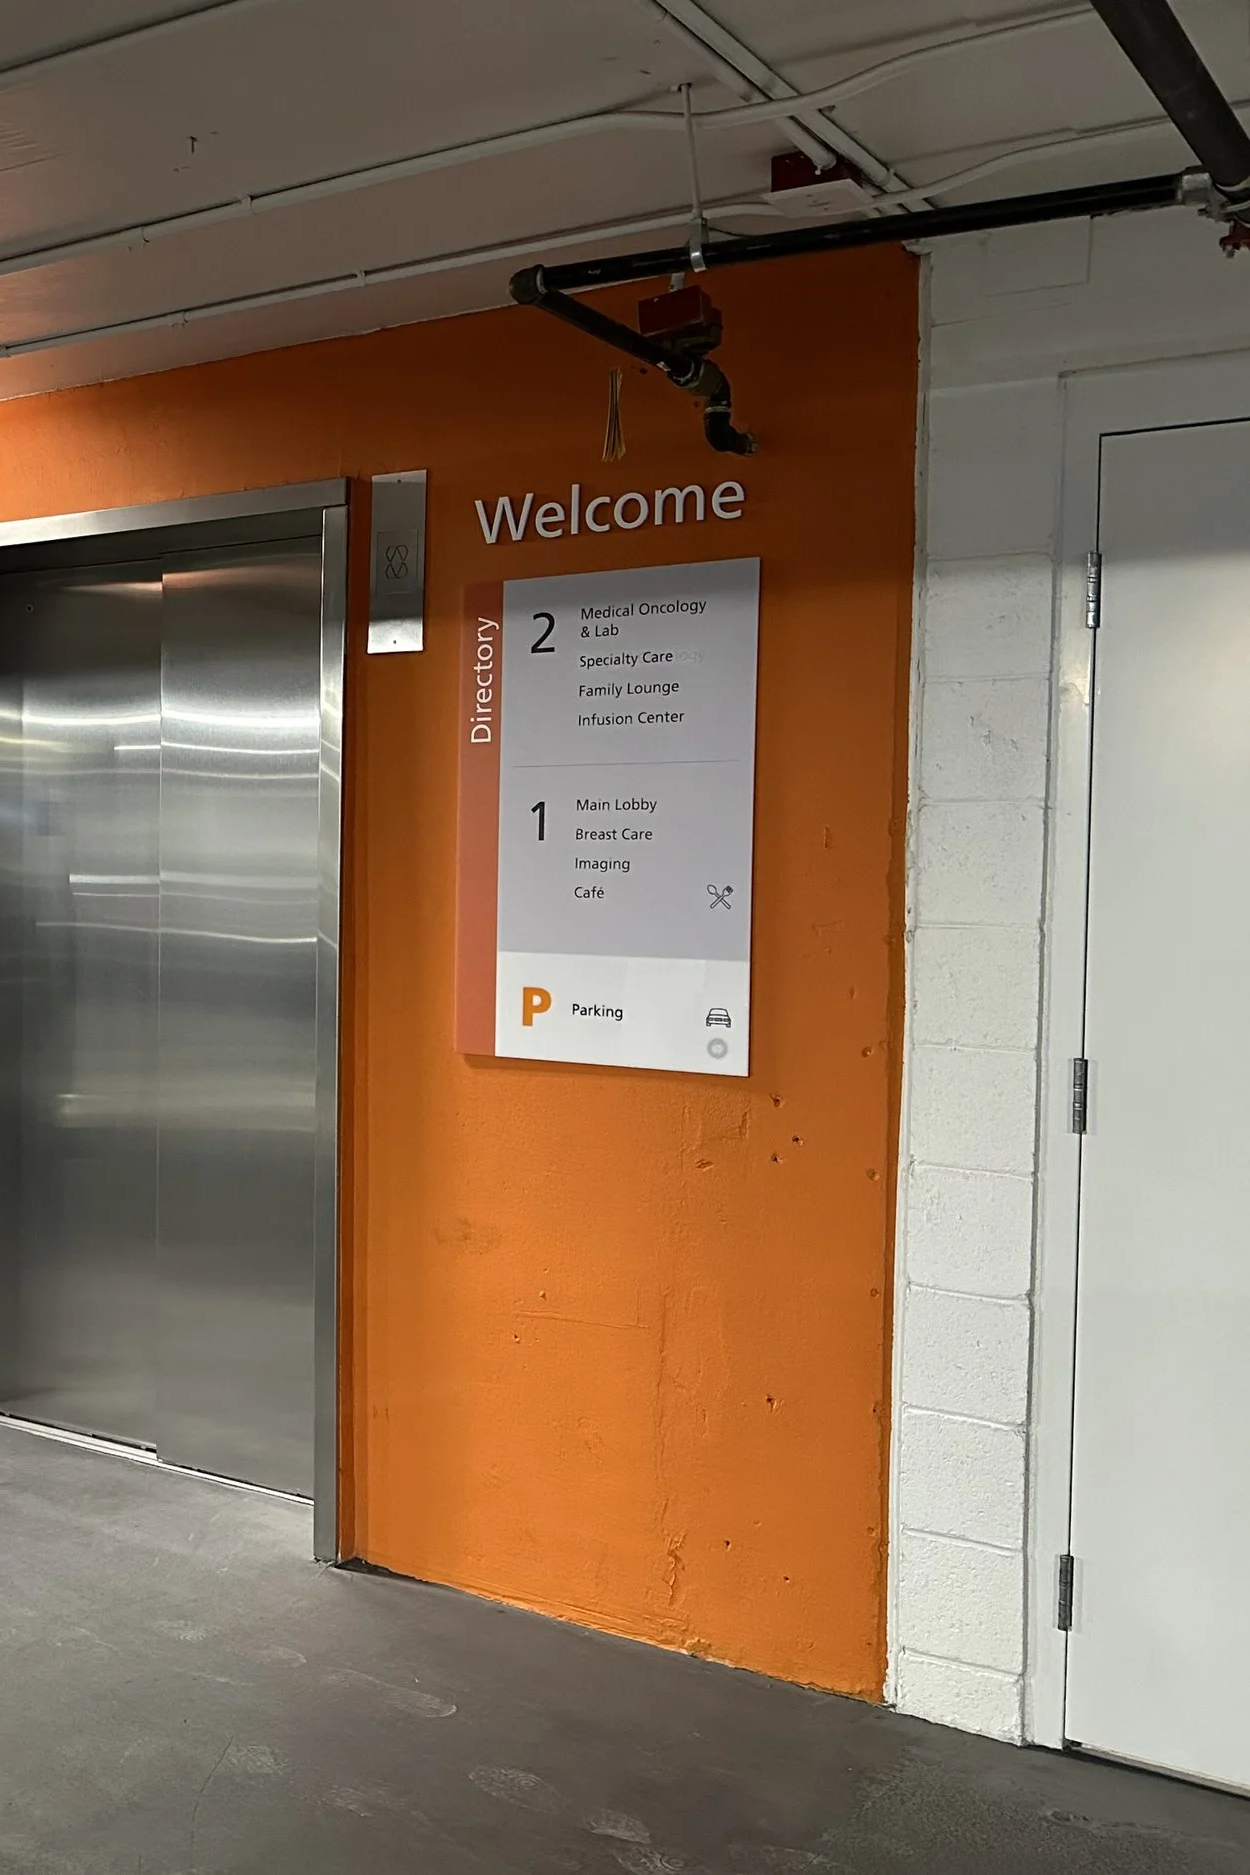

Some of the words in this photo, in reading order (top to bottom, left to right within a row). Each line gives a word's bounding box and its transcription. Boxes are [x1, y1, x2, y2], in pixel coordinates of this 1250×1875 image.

[474, 479, 744, 544] Welcome
[581, 602, 634, 620] Medical
[639, 599, 707, 616] Oncology
[530, 612, 555, 654] 2
[581, 625, 590, 638] &
[595, 624, 619, 637] Lab
[579, 652, 638, 669] Specialty
[642, 650, 673, 664] Care
[470, 616, 499, 744] Directory
[578, 683, 622, 699] Family
[627, 681, 680, 696] Lounge
[578, 713, 632, 727] Infusion
[638, 712, 685, 724] Center
[576, 799, 610, 812] Main
[615, 798, 657, 814] Lobby
[530, 801, 546, 841] 1
[575, 828, 617, 841] Breast
[622, 829, 653, 841] Care
[575, 857, 631, 872] Imaging
[574, 886, 605, 899] Café
[522, 987, 553, 1027] P
[572, 1004, 623, 1020] Parking
